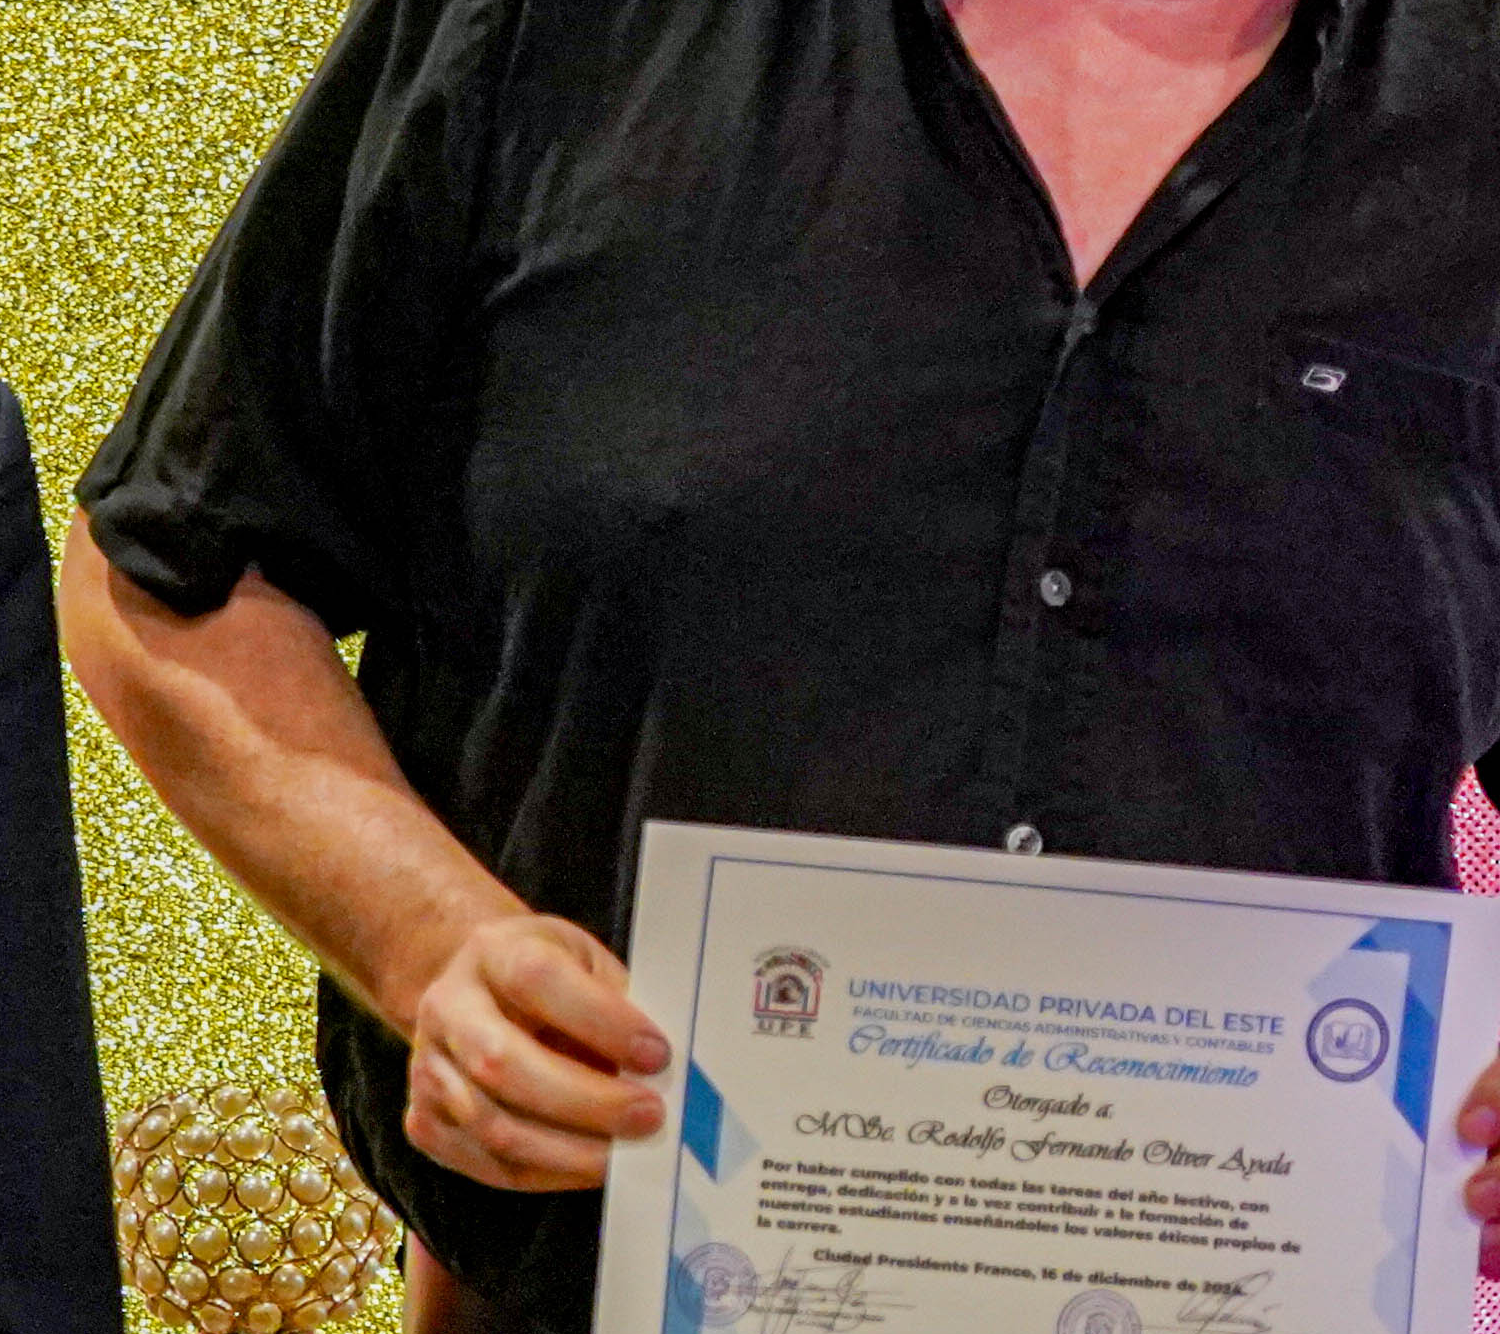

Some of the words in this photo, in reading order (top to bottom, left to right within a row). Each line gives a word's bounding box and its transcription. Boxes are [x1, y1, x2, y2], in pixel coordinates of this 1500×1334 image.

[849, 978, 1031, 1012] UNIVERSIDAD
[1039, 995, 1156, 1024] PRIVADA
[1165, 1006, 1216, 1029] DEL
[1223, 1012, 1285, 1036] ESTE
[853, 1007, 932, 1023] FACULTAD
[938, 1014, 957, 1027] DE
[962, 1017, 1030, 1033] CIENCIAS
[1034, 1022, 1167, 1045] ADMINISTRATIVAS
[1185, 1036, 1275, 1055] CONTABLES
[849, 1024, 994, 1068] Certificado
[1001, 1038, 1035, 1068] de
[1044, 1042, 1260, 1087] Reconocimiento
[983, 1085, 1090, 1122] Otorgado
[907, 1120, 1006, 1159] Rodolfo
[1011, 1132, 1135, 1162] Fernando
[1143, 1140, 1216, 1168] Oliver
[1218, 1147, 1294, 1180] Ayala
[760, 1179, 832, 1197] entrega,
[837, 1184, 929, 1203] dedicación
[934, 1195, 943, 1207] y
[949, 1195, 959, 1206] a
[964, 1194, 978, 1207] la
[984, 1198, 1011, 1210] vez
[1017, 1201, 1100, 1219] contribuir
[1104, 1208, 1115, 1219] a
[1120, 1208, 1134, 1221] la
[1139, 1210, 1224, 1229] formación
[1228, 1216, 1250, 1230] de
[762, 1158, 792, 1172] Por
[797, 1161, 845, 1177] haber
[851, 1167, 929, 1185] cumplido
[934, 1175, 965, 1186] con
[970, 1176, 1017, 1192] todas
[1022, 1180, 1044, 1193] las
[1051, 1183, 1103, 1199] tareas
[1108, 1188, 1134, 1202] del
[1138, 1190, 1169, 1205] año
[1174, 1194, 1234, 1212] lectivo,
[1240, 1201, 1270, 1213] con
[757, 1215, 771, 1229] la
[777, 1218, 842, 1234] carrera.
[759, 1198, 833, 1214] nuestros
[839, 1205, 938, 1224] estudiantes
[1064, 1222, 1088, 1236] los
[1093, 1225, 1153, 1242] valores
[1158, 1230, 1209, 1246] éticos
[1213, 1235, 1276, 1253] propios
[1280, 1240, 1301, 1254] de
[813, 1247, 872, 1267] Ciudad
[877, 1253, 969, 1274] Presidente
[974, 1261, 1037, 1280] Franco,
[1041, 1267, 1058, 1281] 16
[1062, 1269, 1083, 1283] de
[1088, 1271, 1171, 1292] diciembre
[1176, 1278, 1198, 1293] de
